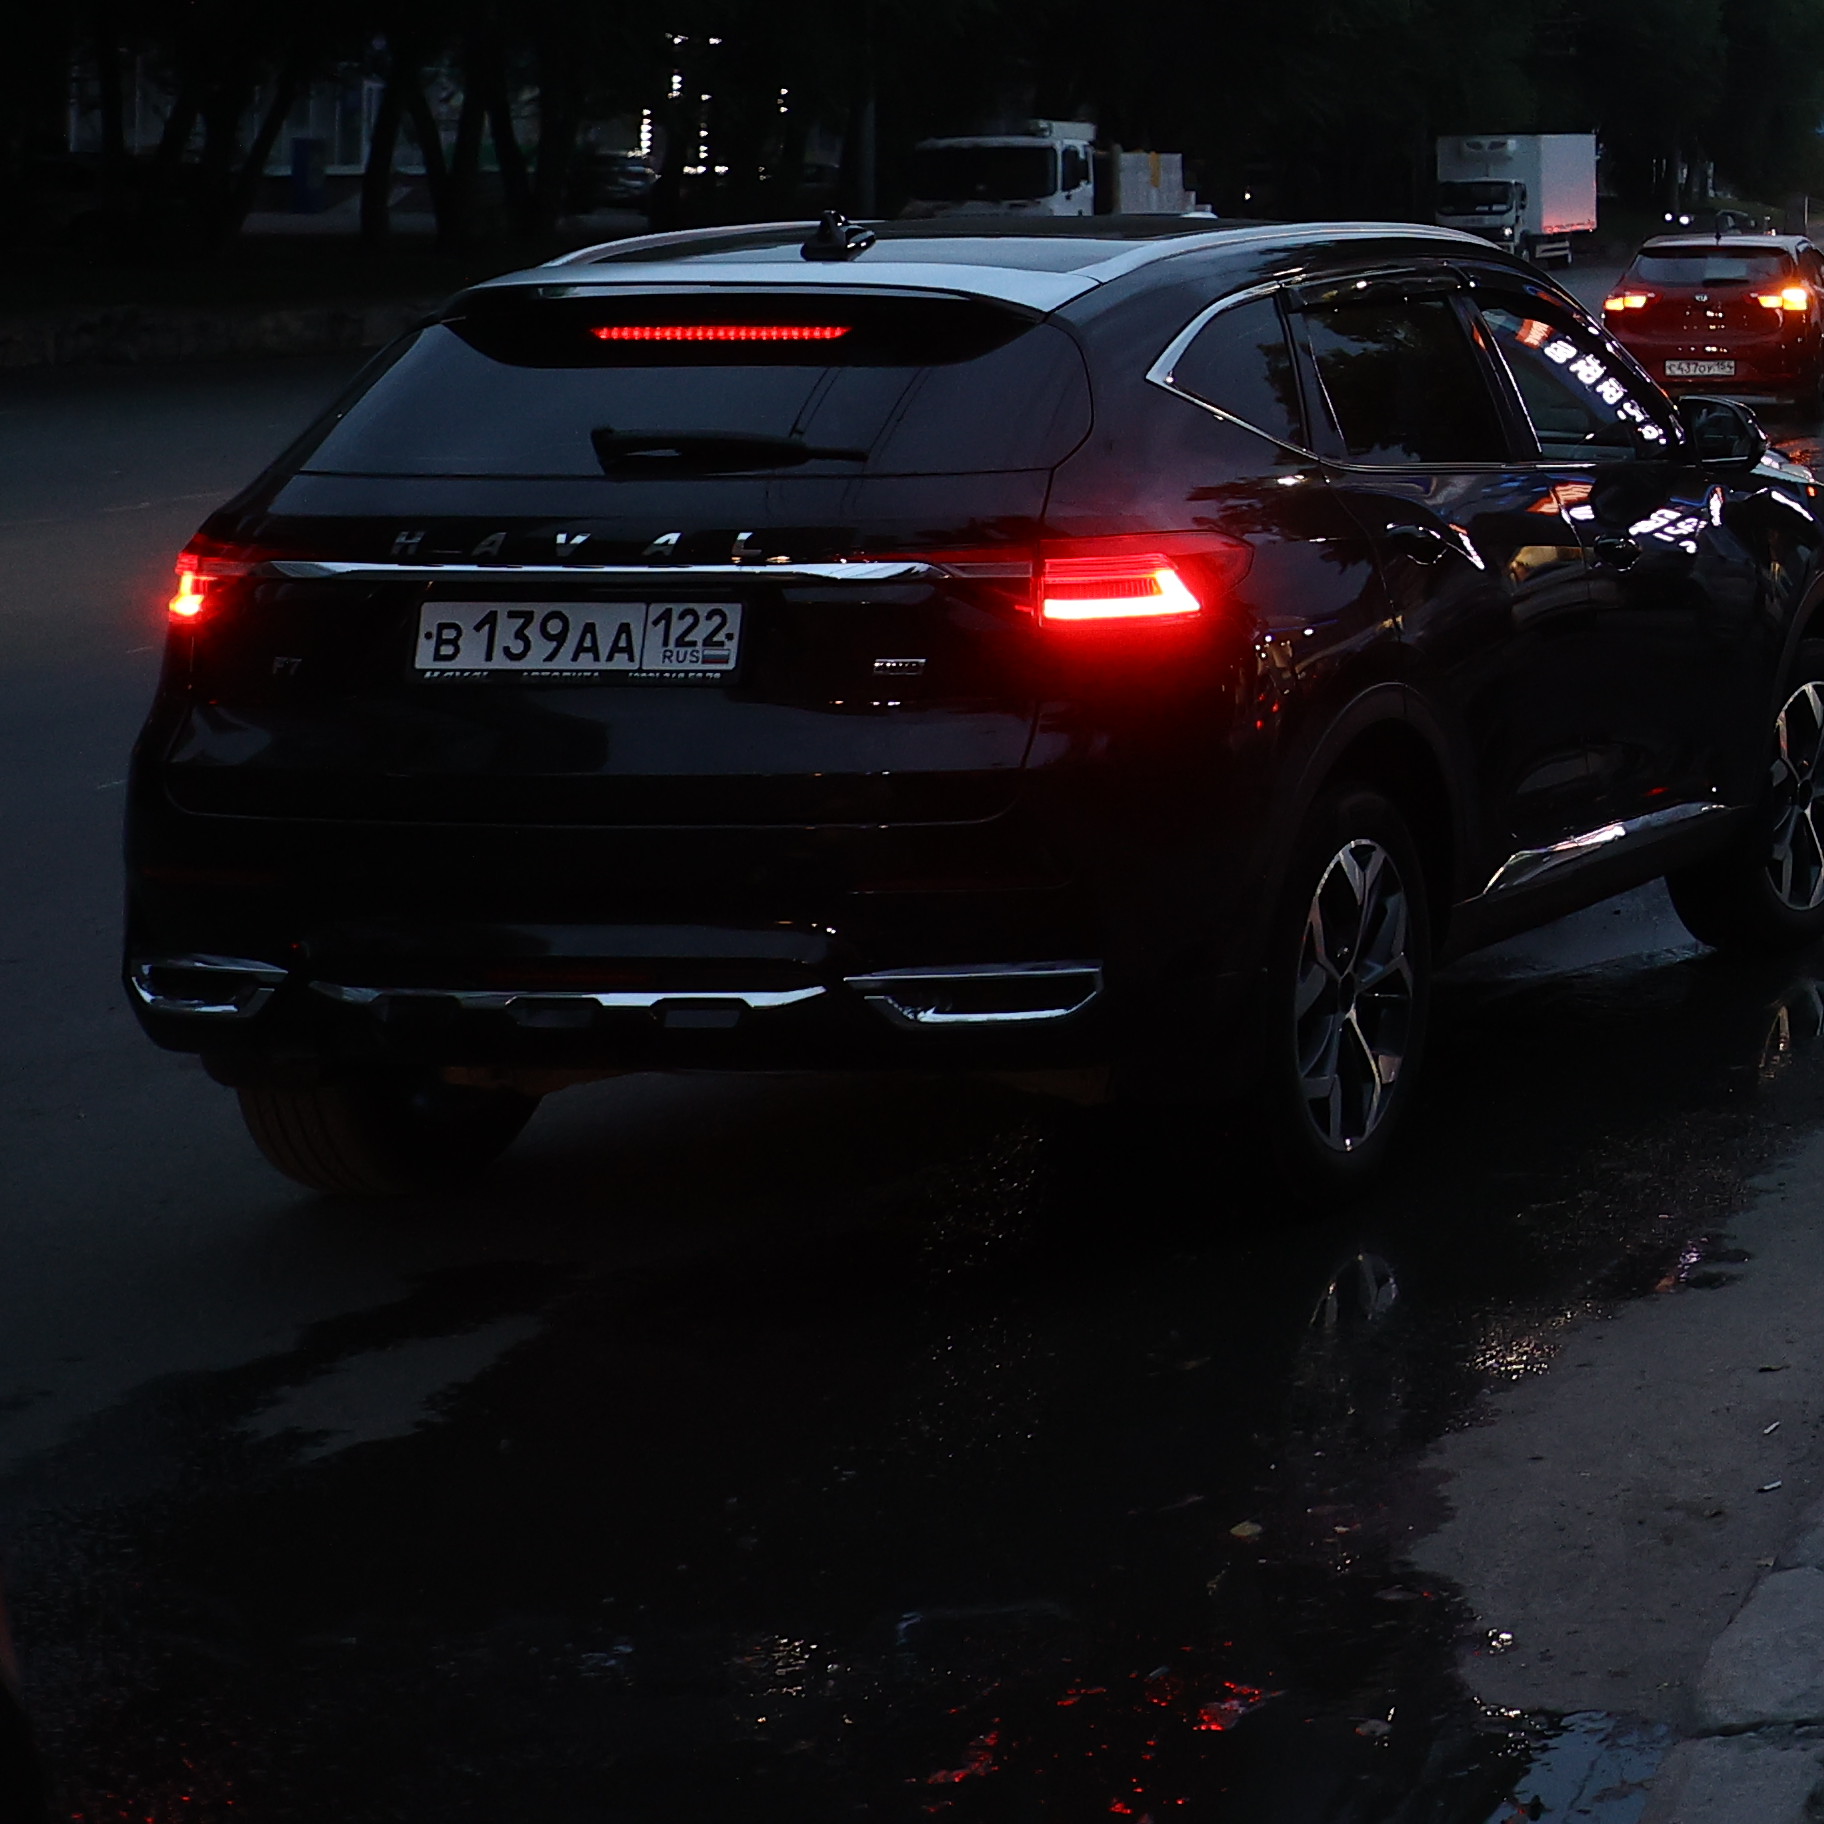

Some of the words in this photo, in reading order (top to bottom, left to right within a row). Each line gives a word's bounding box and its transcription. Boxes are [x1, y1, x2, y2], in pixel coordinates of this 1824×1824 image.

[390, 530, 763, 557] HAVAL
[651, 607, 729, 648] 122
[661, 649, 700, 664] RUS
